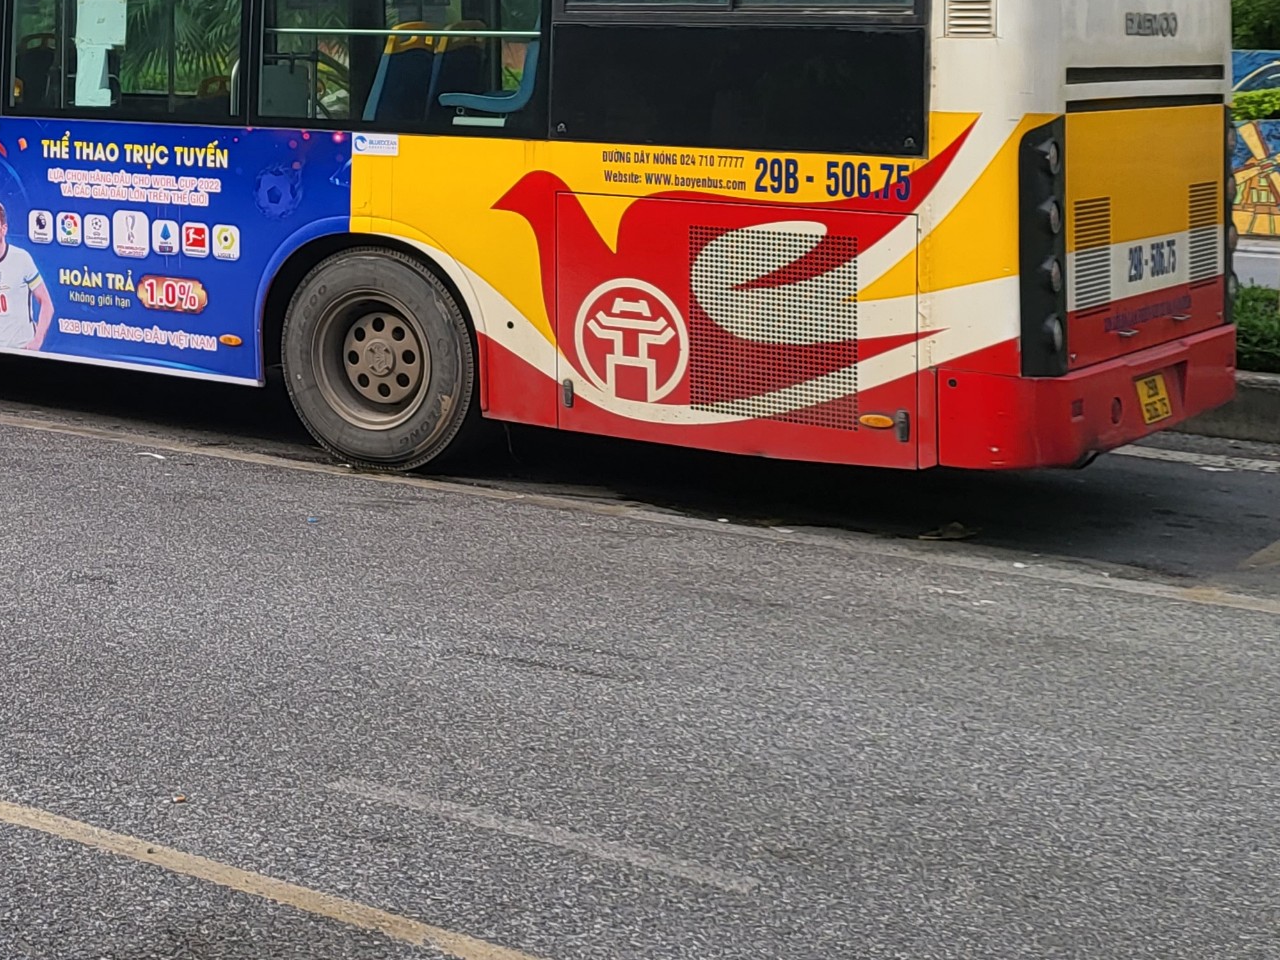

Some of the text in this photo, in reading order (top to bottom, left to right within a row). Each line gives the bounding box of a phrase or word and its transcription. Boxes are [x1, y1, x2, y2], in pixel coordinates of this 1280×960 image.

[1125, 12, 1178, 37] DAEWOO
[41, 130, 229, 170] THỂ THAO TRỰC TUYẾN
[602, 148, 631, 164] ĐƯỜNG
[634, 150, 650, 164] DÂY
[680, 153, 696, 166] 024
[699, 154, 715, 167] 710
[717, 155, 745, 169] 77777
[89, 170, 112, 184] HÀNG
[132, 174, 151, 186] CHO
[152, 175, 177, 189] WORL
[178, 176, 196, 190] CUP
[197, 178, 221, 192] 2022
[604, 170, 746, 191] Website: WWW.baoyenbus.com
[754, 157, 799, 194] 29B
[825, 160, 911, 201] 506.75
[59, 266, 135, 292] HOÀN TRẢ
[69, 290, 131, 309] Không giới hạn
[145, 279, 199, 310] 1.0%
[59, 318, 82, 333] 123B
[81, 320, 96, 336] UY
[113, 323, 143, 342] HÀNG
[190, 334, 218, 352] NAM
